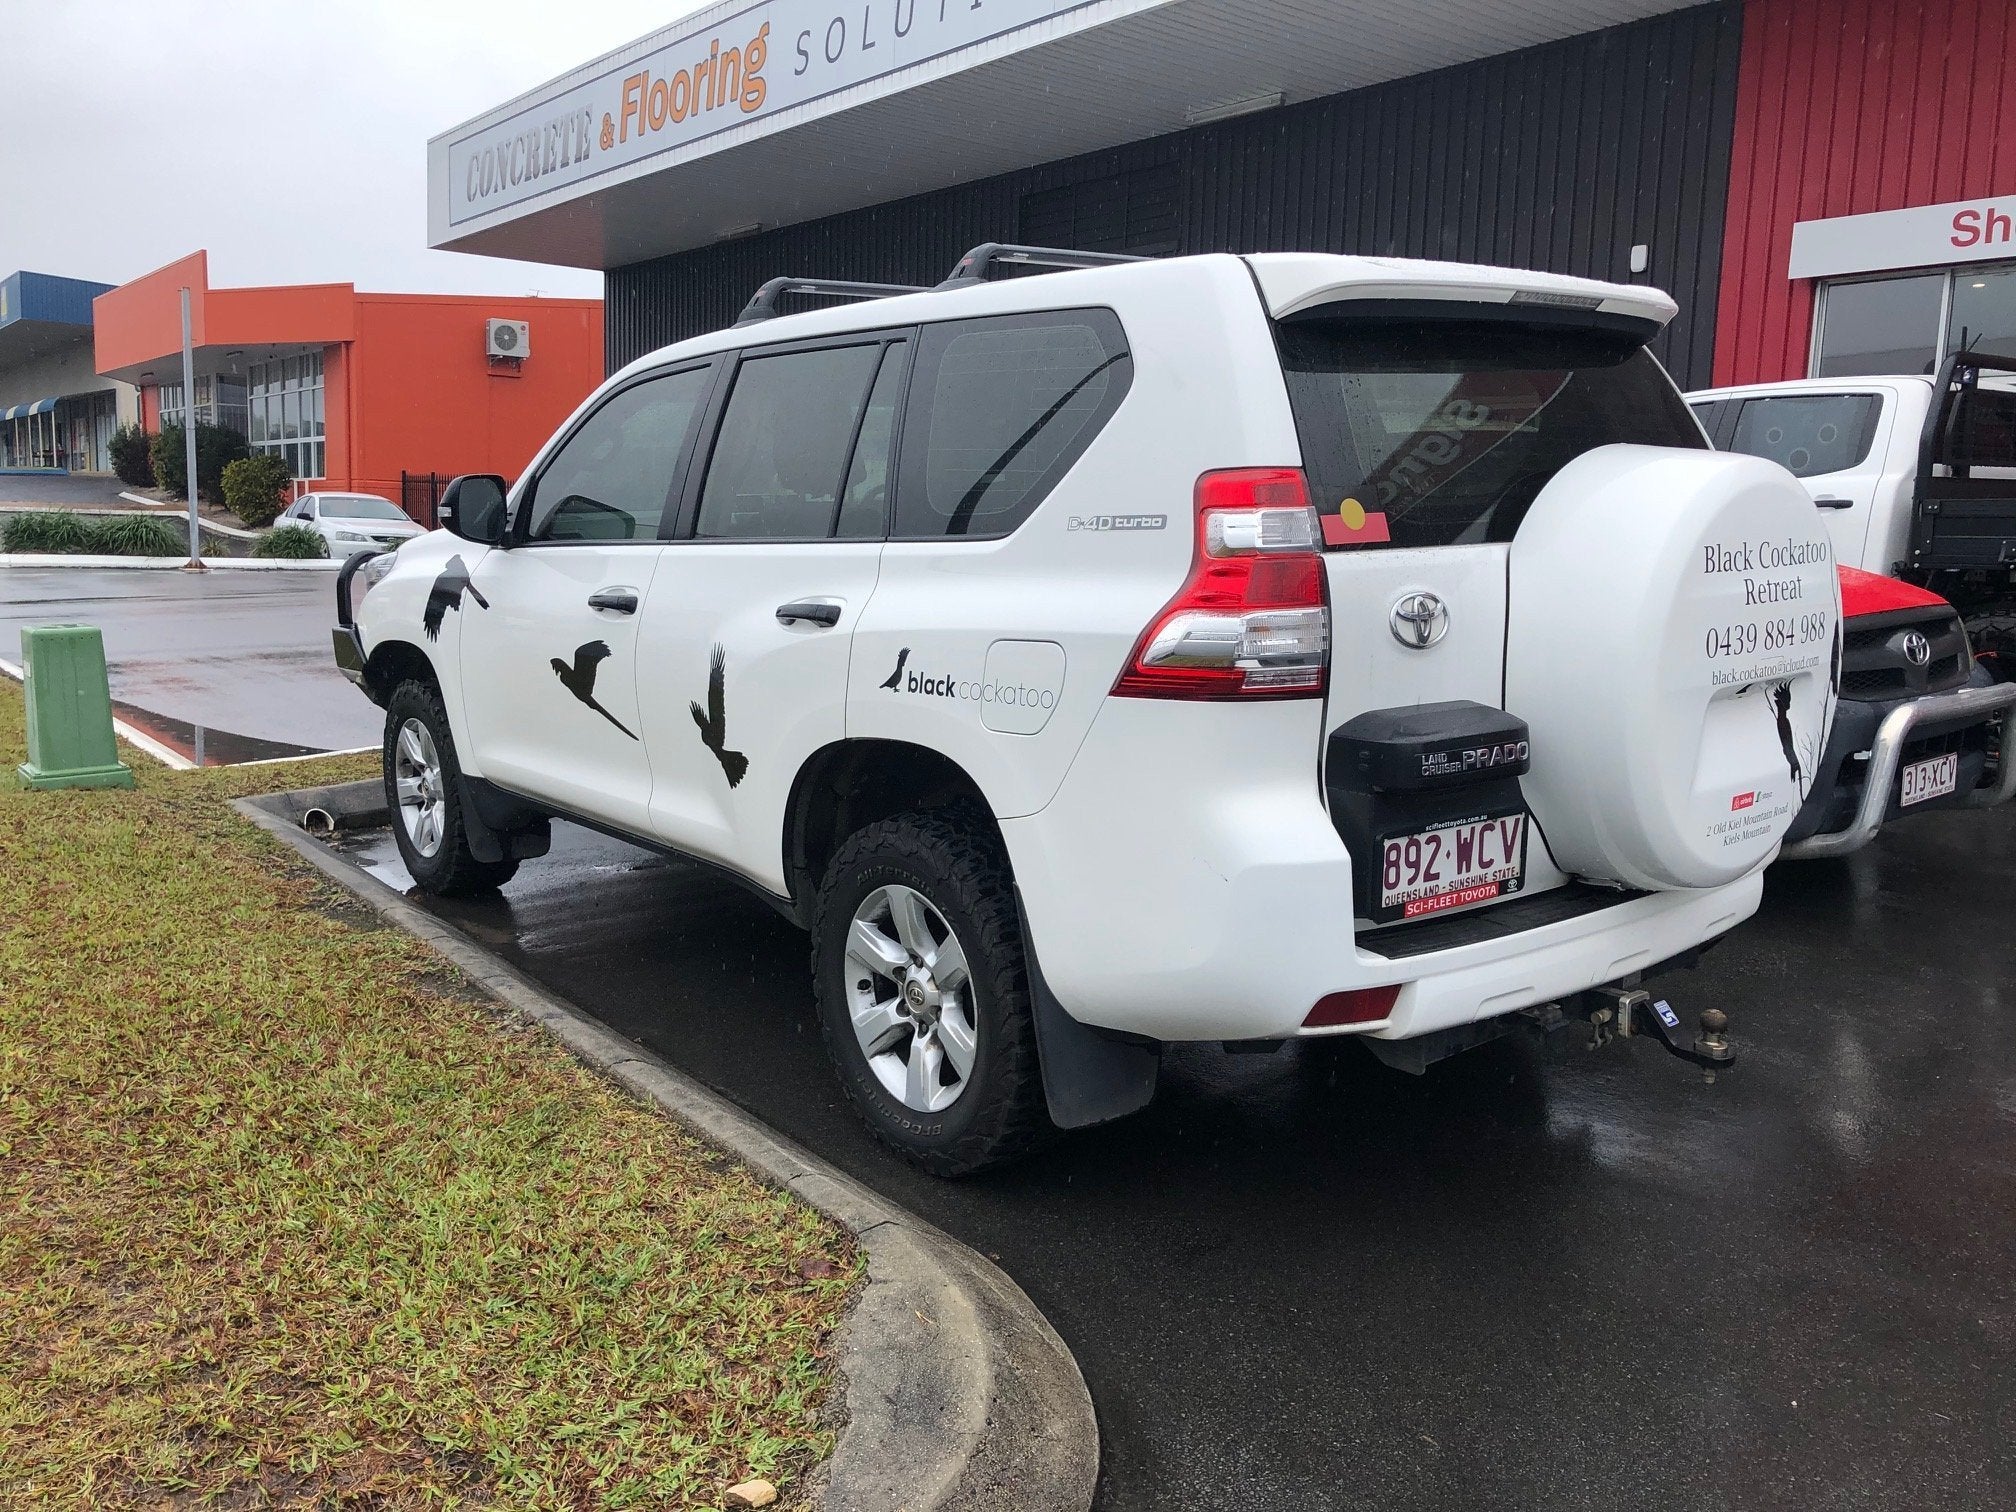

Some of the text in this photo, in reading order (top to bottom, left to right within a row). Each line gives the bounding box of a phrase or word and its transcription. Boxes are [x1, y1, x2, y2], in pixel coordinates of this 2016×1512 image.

[466, 0, 982, 203] CONCRETE & Flooring SOLU
[1951, 208, 2016, 247] Sh
[1115, 517, 1163, 528] turbo
[1704, 538, 1826, 573] Black Cockatoo
[1744, 576, 1802, 605] Retreat
[1706, 612, 1825, 658] 0439 884 988
[1422, 753, 1447, 765] LAND
[1422, 762, 1462, 776] CRUISER
[1462, 741, 1529, 771] PRADO
[1706, 826, 1711, 837] 2
[1713, 822, 1727, 836] Old
[1743, 810, 1773, 826] Mountain
[1773, 802, 1788, 818] Road
[1741, 824, 1771, 842] Mountain
[1384, 885, 1440, 907] QUEENSLAND
[1449, 871, 1488, 890] SUNSHINE
[1407, 885, 1497, 915] SCI-FLEET TOYOTA
